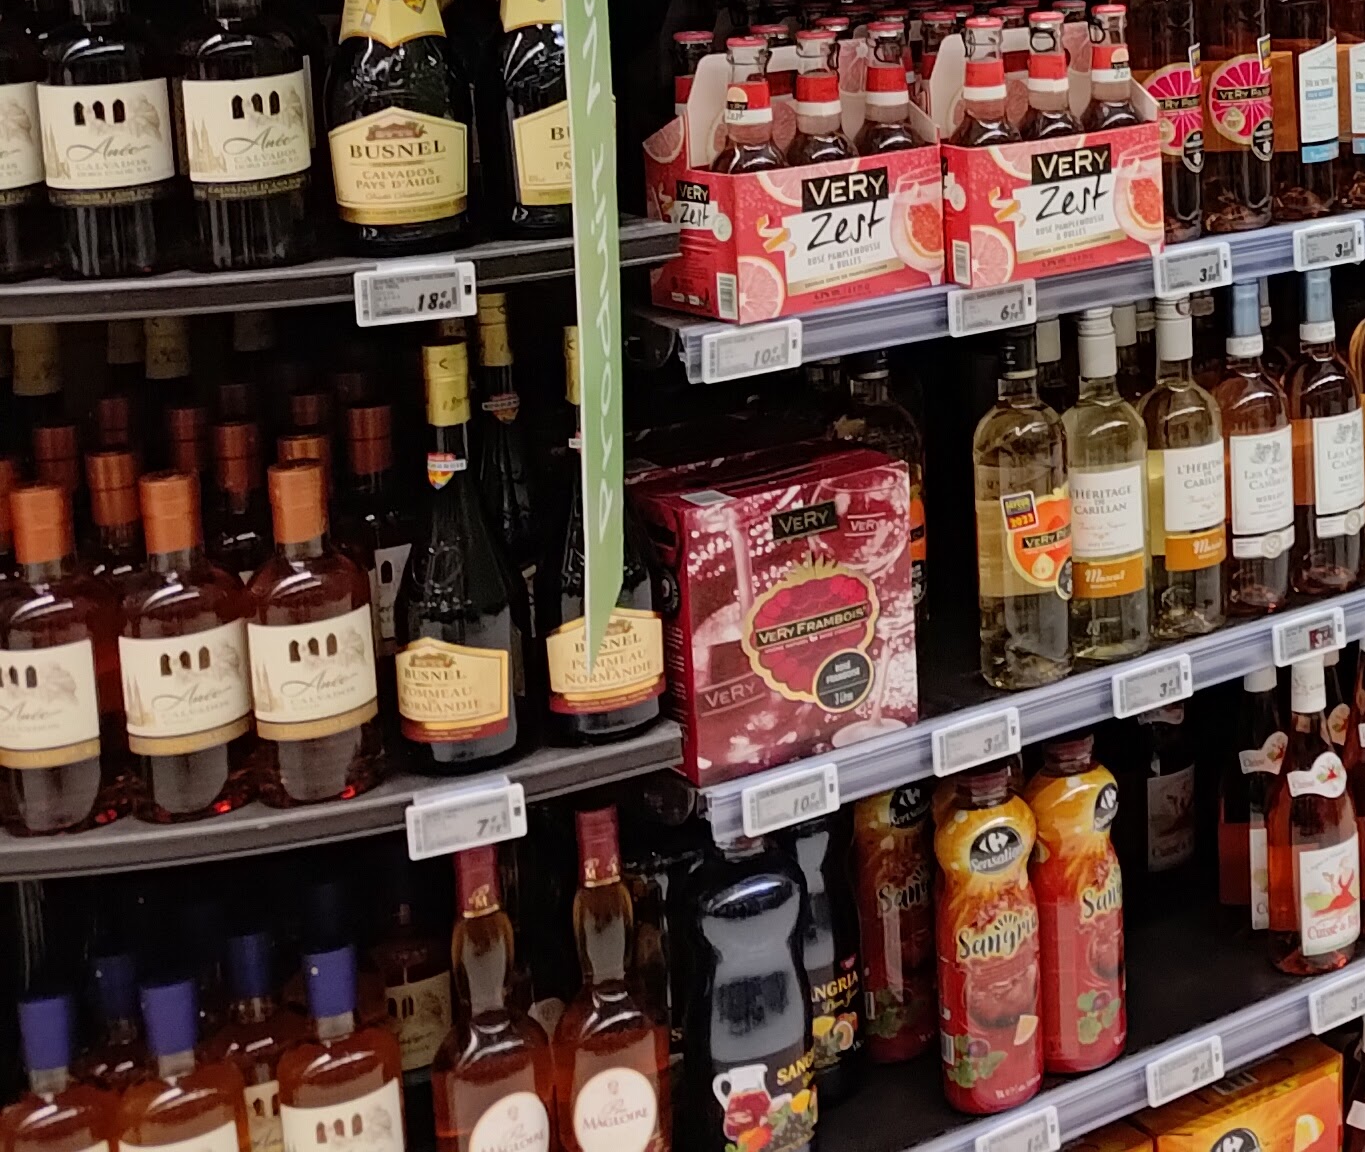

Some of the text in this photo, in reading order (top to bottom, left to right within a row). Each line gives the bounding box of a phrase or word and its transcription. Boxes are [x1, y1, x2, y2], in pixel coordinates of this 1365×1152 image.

[349, 138, 447, 161] BUSNEL
[361, 166, 435, 181] CALVADOS
[1036, 151, 1110, 179] VERY
[355, 179, 387, 191] PAYS
[677, 182, 709, 202] VERY
[806, 174, 886, 207] VERY
[1035, 174, 1110, 221] Zest
[806, 199, 888, 252] Zest
[1073, 501, 1128, 517] CARILLAN
[779, 509, 829, 534] VERY
[849, 519, 881, 532] VERY
[758, 627, 796, 644] VERY
[403, 667, 468, 682] BUSNEL
[402, 684, 473, 698] POMMEAU
[704, 681, 756, 709] VERY
